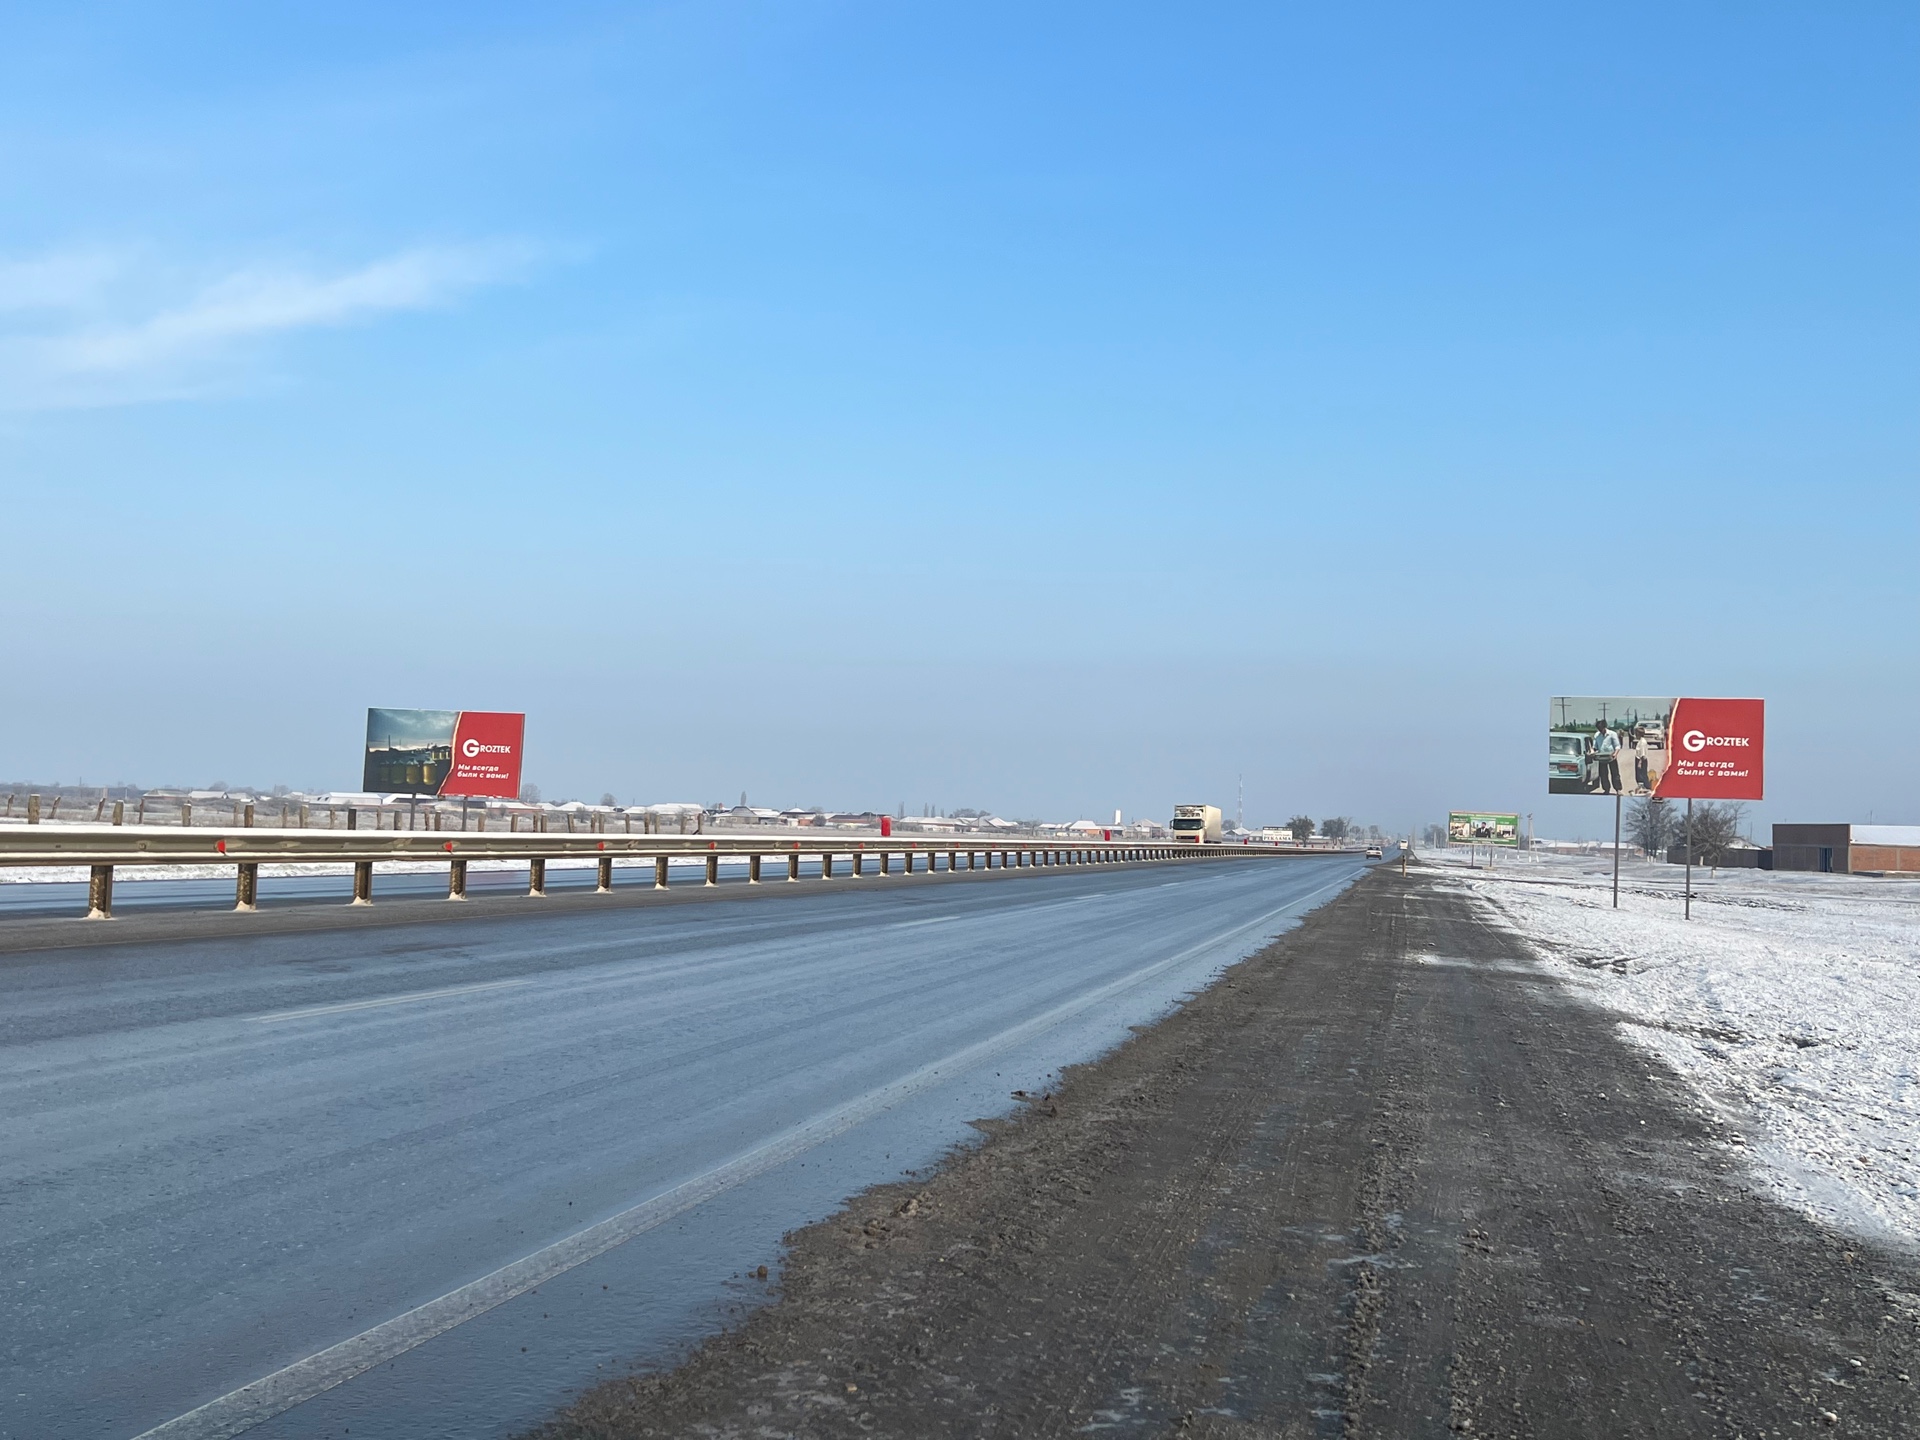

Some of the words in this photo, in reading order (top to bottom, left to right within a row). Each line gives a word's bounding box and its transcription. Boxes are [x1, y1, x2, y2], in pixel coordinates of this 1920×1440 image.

[462, 738, 511, 758] GROZTEK
[1682, 730, 1750, 752] GROZTEK
[1677, 767, 1706, 776] были
[1708, 769, 1715, 777] с
[1717, 769, 1749, 777] вами!
